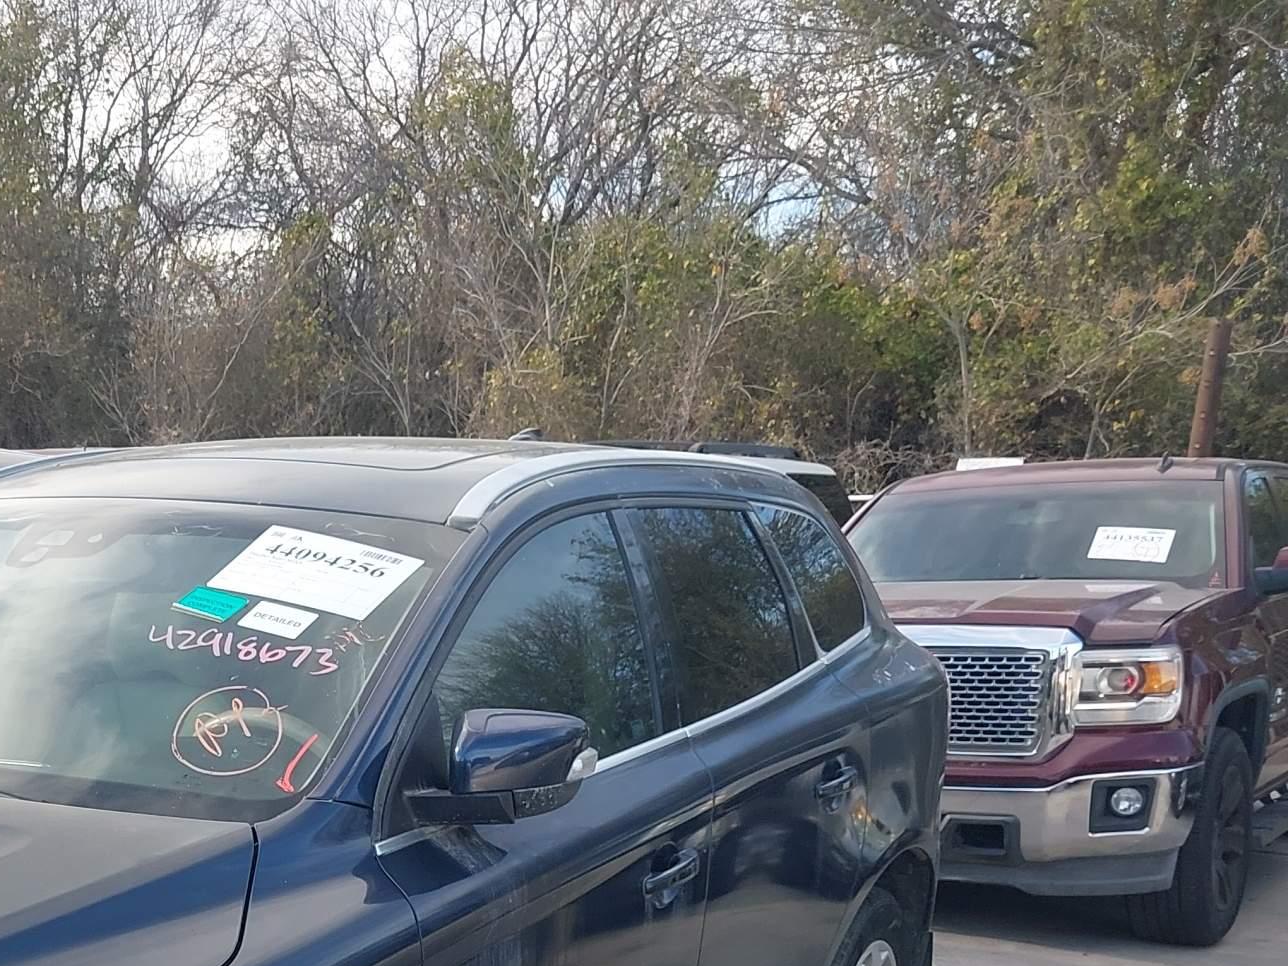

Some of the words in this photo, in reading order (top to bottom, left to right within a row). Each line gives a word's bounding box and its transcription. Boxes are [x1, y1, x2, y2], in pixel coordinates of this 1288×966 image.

[265, 543, 387, 578] 44094256
[253, 611, 302, 628] DETAILED
[148, 624, 339, 675] 42918673
